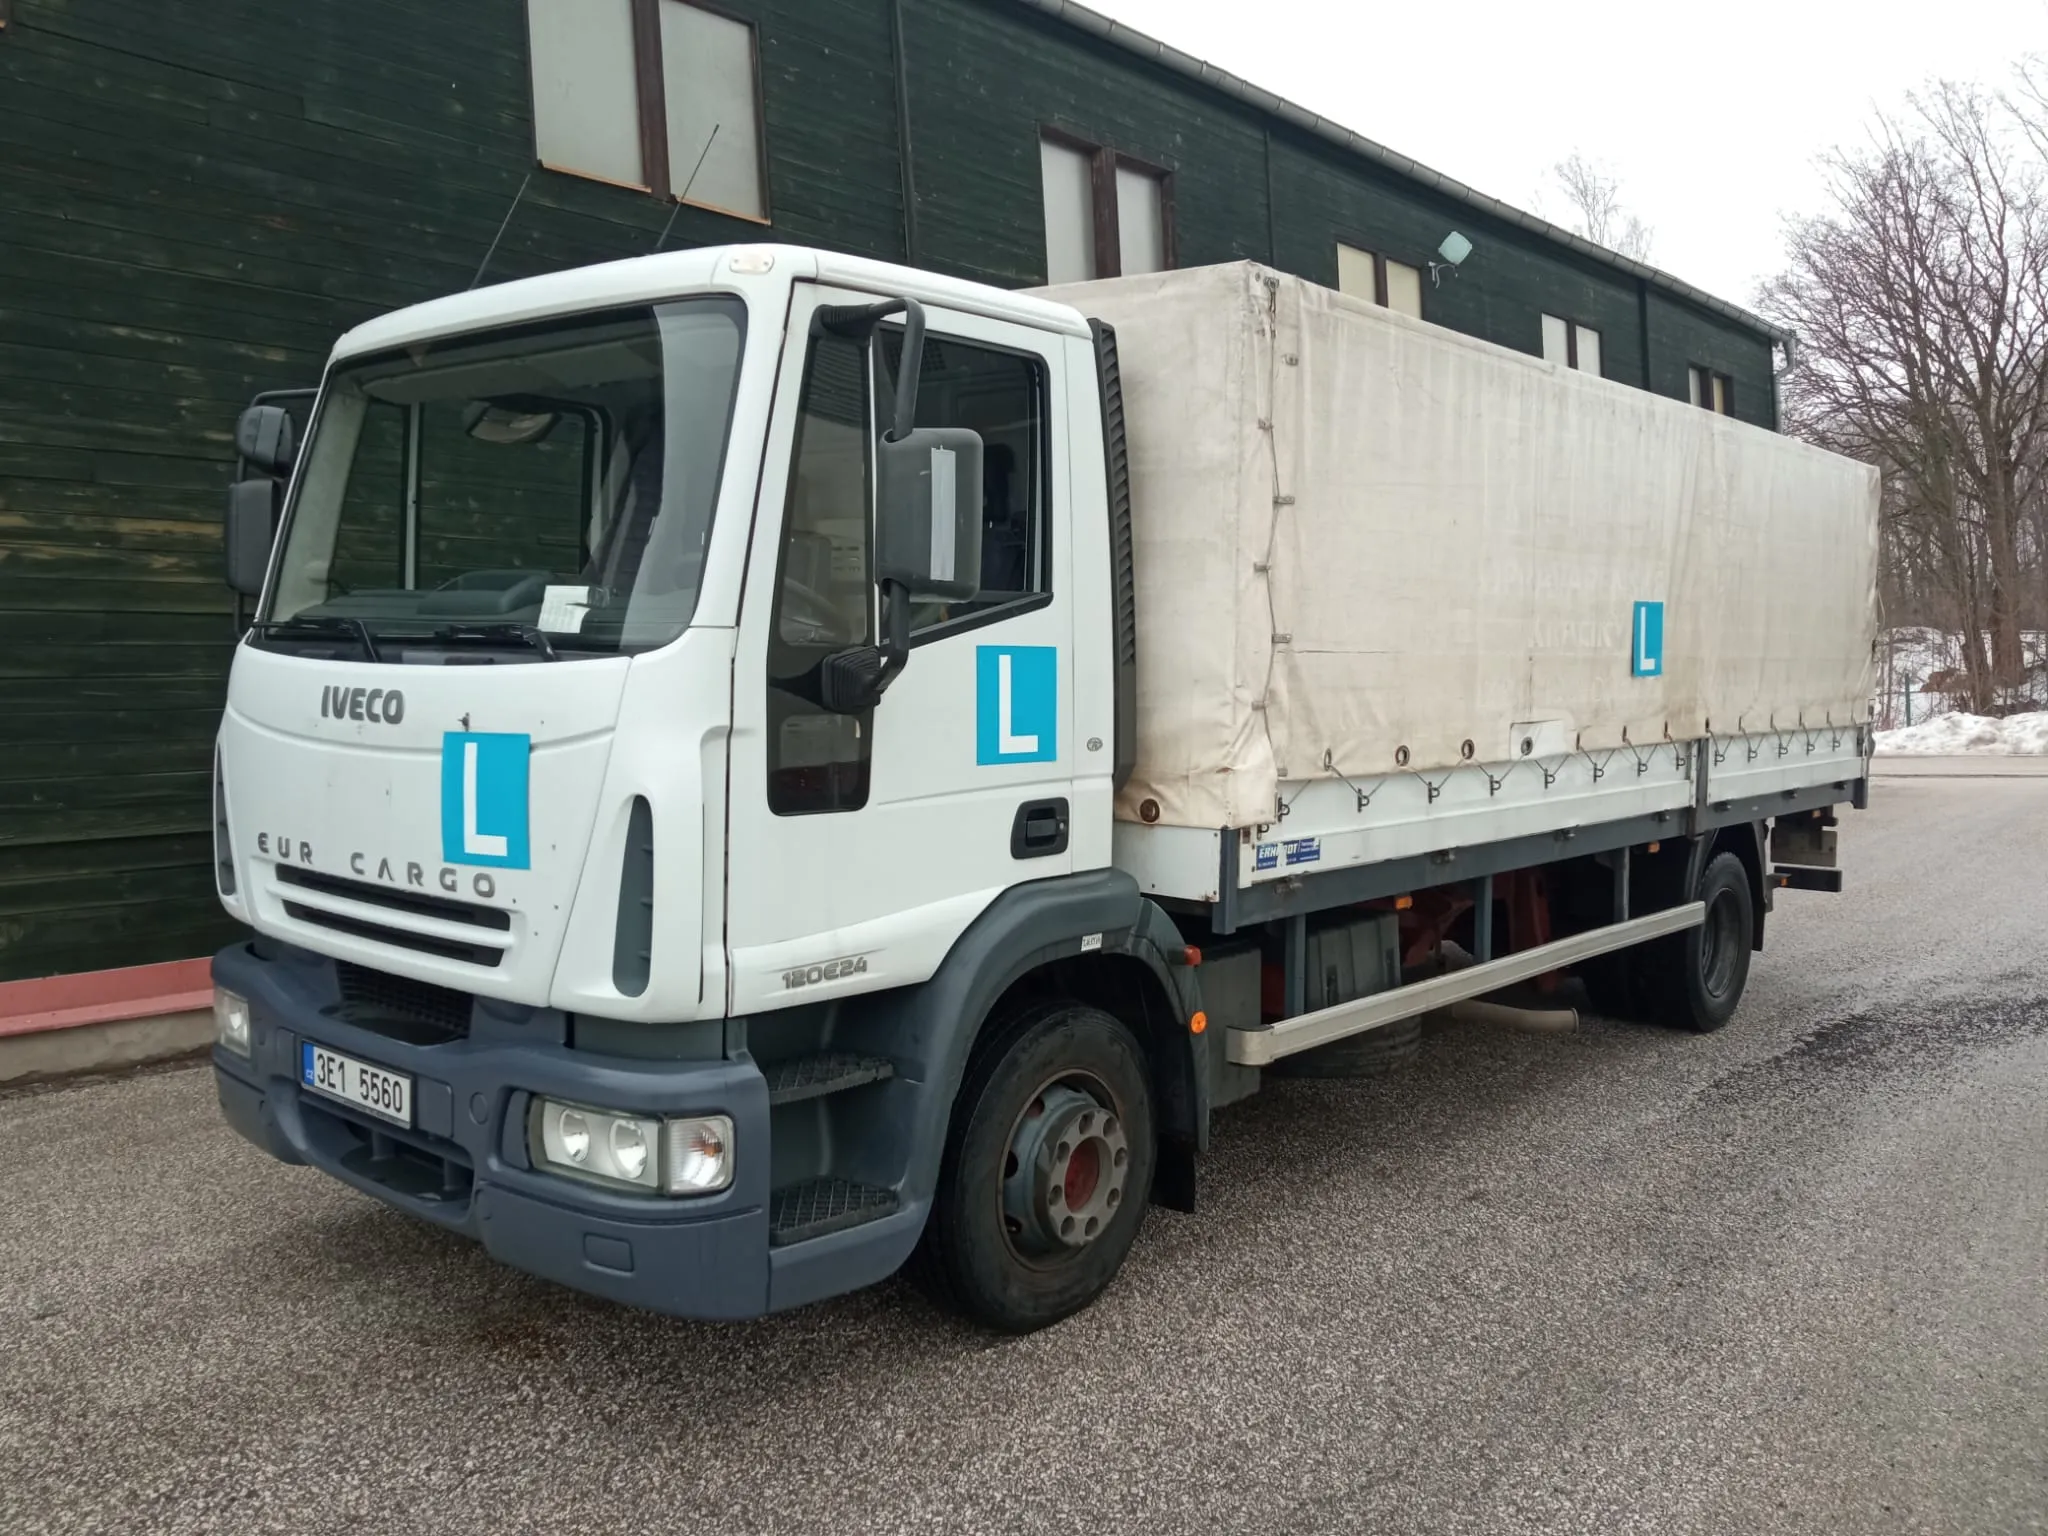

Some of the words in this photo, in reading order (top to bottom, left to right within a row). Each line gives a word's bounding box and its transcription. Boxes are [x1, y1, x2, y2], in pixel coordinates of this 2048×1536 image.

[1640, 606, 1656, 671] L
[321, 685, 405, 725] IVECO
[998, 654, 1039, 754] L
[463, 742, 508, 857] L
[350, 852, 496, 898] CARGO
[1258, 843, 1299, 859] ERHDT
[782, 956, 868, 989] 120E24
[316, 1053, 346, 1093] 3E1
[359, 1067, 403, 1113] 5560
